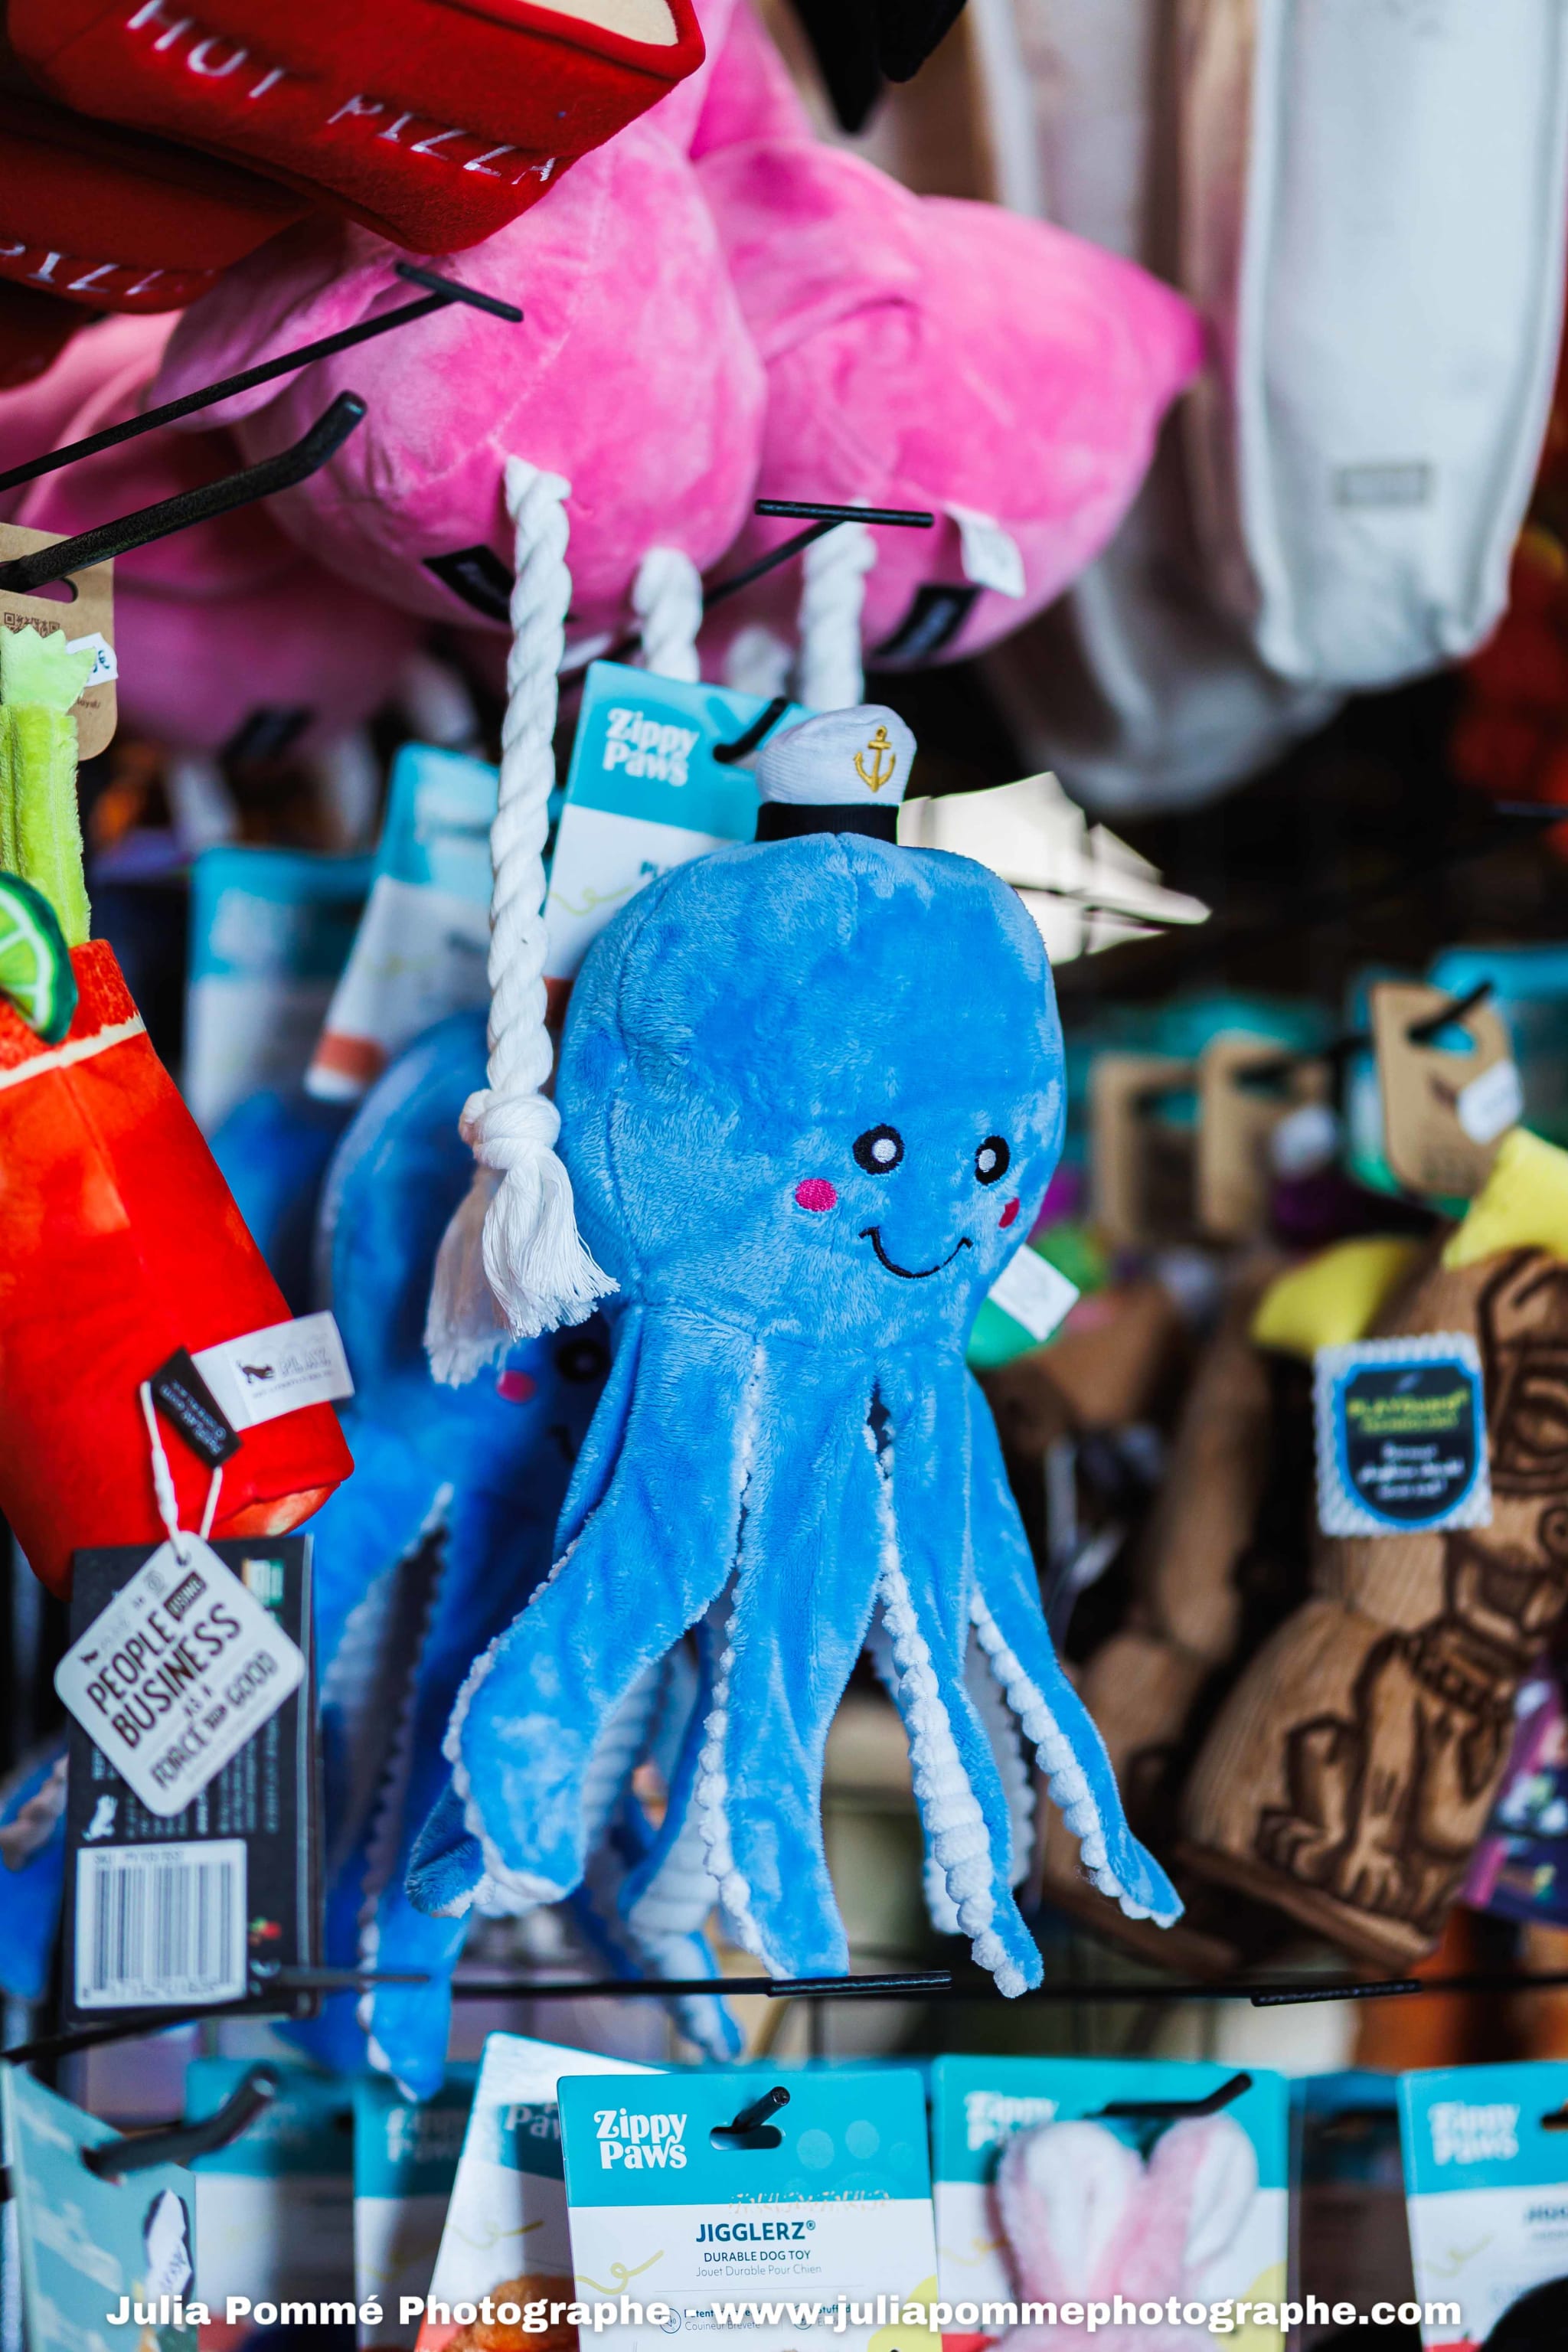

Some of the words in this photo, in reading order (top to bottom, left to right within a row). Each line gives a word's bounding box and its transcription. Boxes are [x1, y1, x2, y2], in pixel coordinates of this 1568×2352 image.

[606, 707, 700, 755] Zippy
[603, 740, 689, 787] Paws
[87, 1609, 176, 1716] PEOPLE
[112, 1602, 241, 1749] BUSINESS
[151, 1724, 209, 1788] FORCE
[226, 1651, 277, 1707] GOOD
[594, 2108, 687, 2145] Zippy
[599, 2137, 687, 2169] Paws
[696, 2265, 723, 2277] Jouet
[726, 2265, 766, 2276] Durable
[768, 2265, 790, 2275] Pour
[792, 2264, 822, 2274] Chien
[704, 2251, 756, 2262] DURABLE
[760, 2250, 786, 2261] DOG
[788, 2250, 811, 2260] TOY
